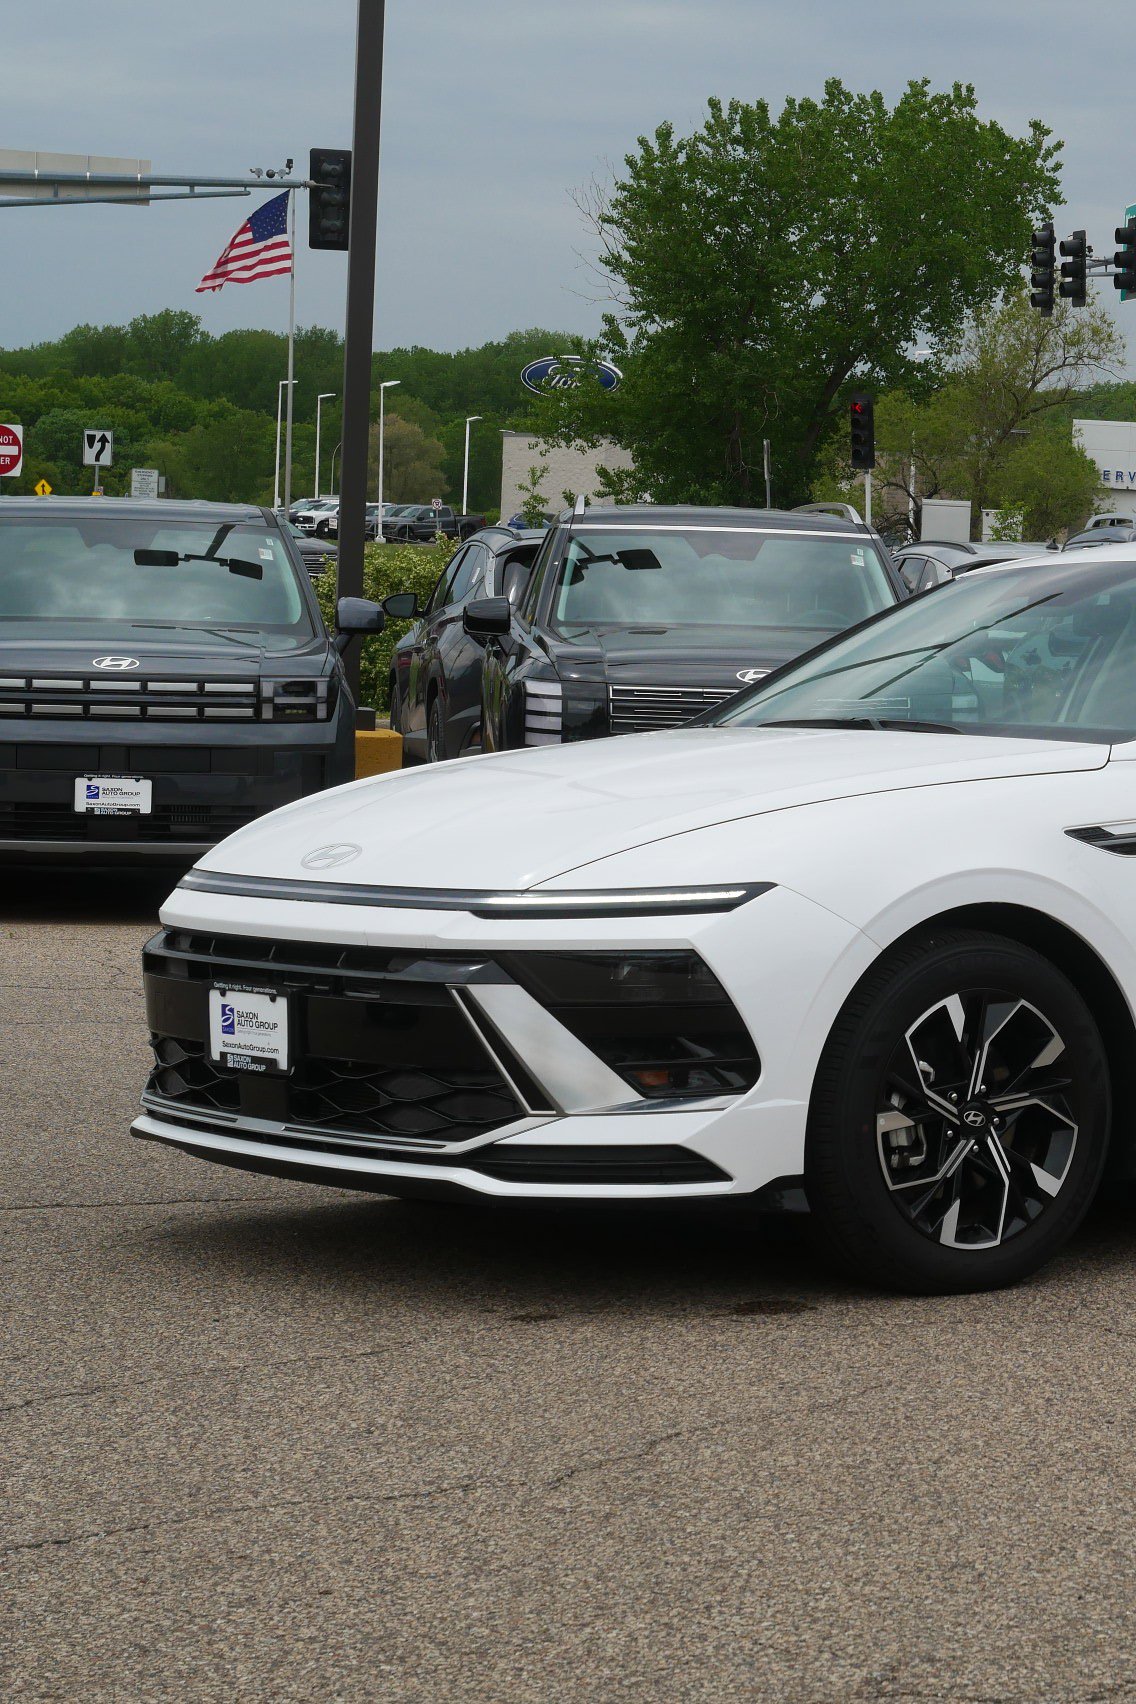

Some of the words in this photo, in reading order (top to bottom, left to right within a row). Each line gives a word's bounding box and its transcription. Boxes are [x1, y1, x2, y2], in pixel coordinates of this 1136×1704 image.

[236, 1010, 259, 1021] SAXON
[236, 1019, 254, 1029] AUTO
[255, 1020, 278, 1031] GROUP
[222, 1040, 279, 1054] SaxonAutoGroup.com
[233, 1054, 251, 1063] SAXON
[233, 1060, 247, 1069] AUTO
[248, 1062, 266, 1072] GROUP
